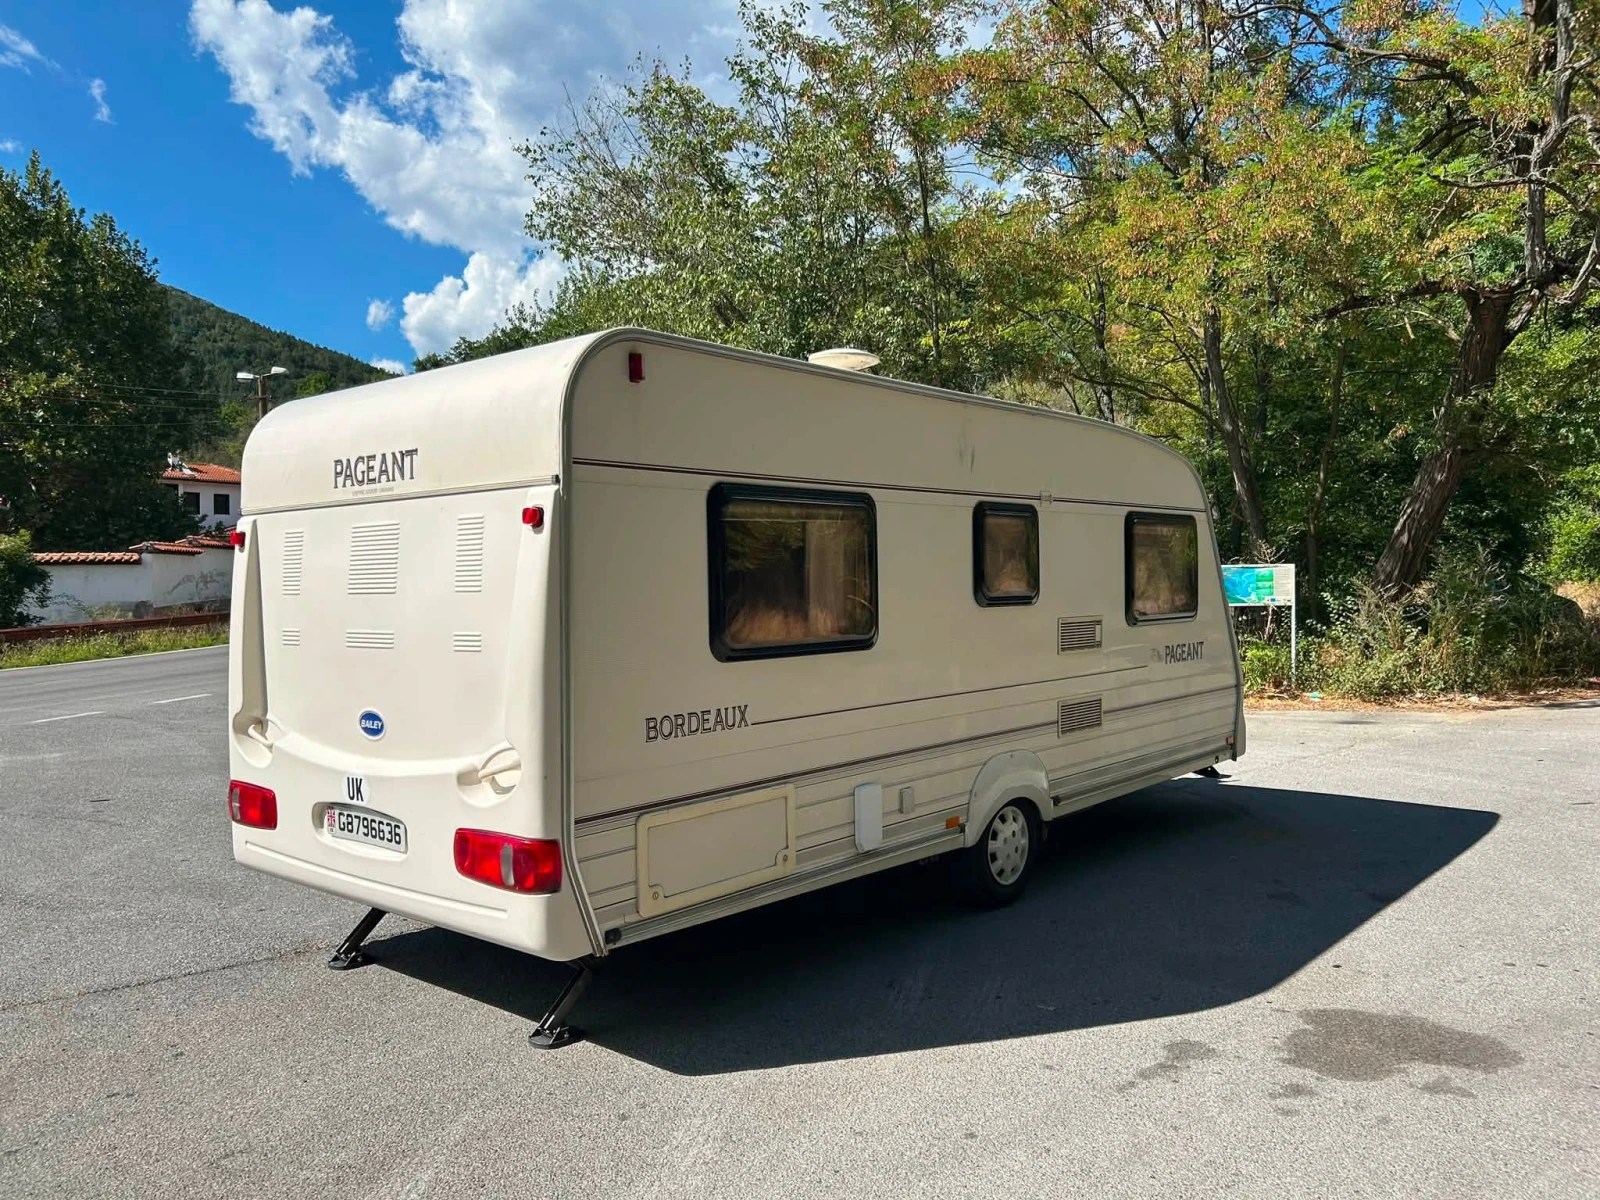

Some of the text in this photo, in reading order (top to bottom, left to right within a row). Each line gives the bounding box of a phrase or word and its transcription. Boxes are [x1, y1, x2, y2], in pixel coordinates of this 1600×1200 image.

[333, 448, 418, 489] PAGEANT
[1164, 641, 1205, 665] PAGEANT
[361, 719, 383, 730] BAILEY
[645, 704, 749, 743] BORDEAUX
[347, 777, 364, 802] UK
